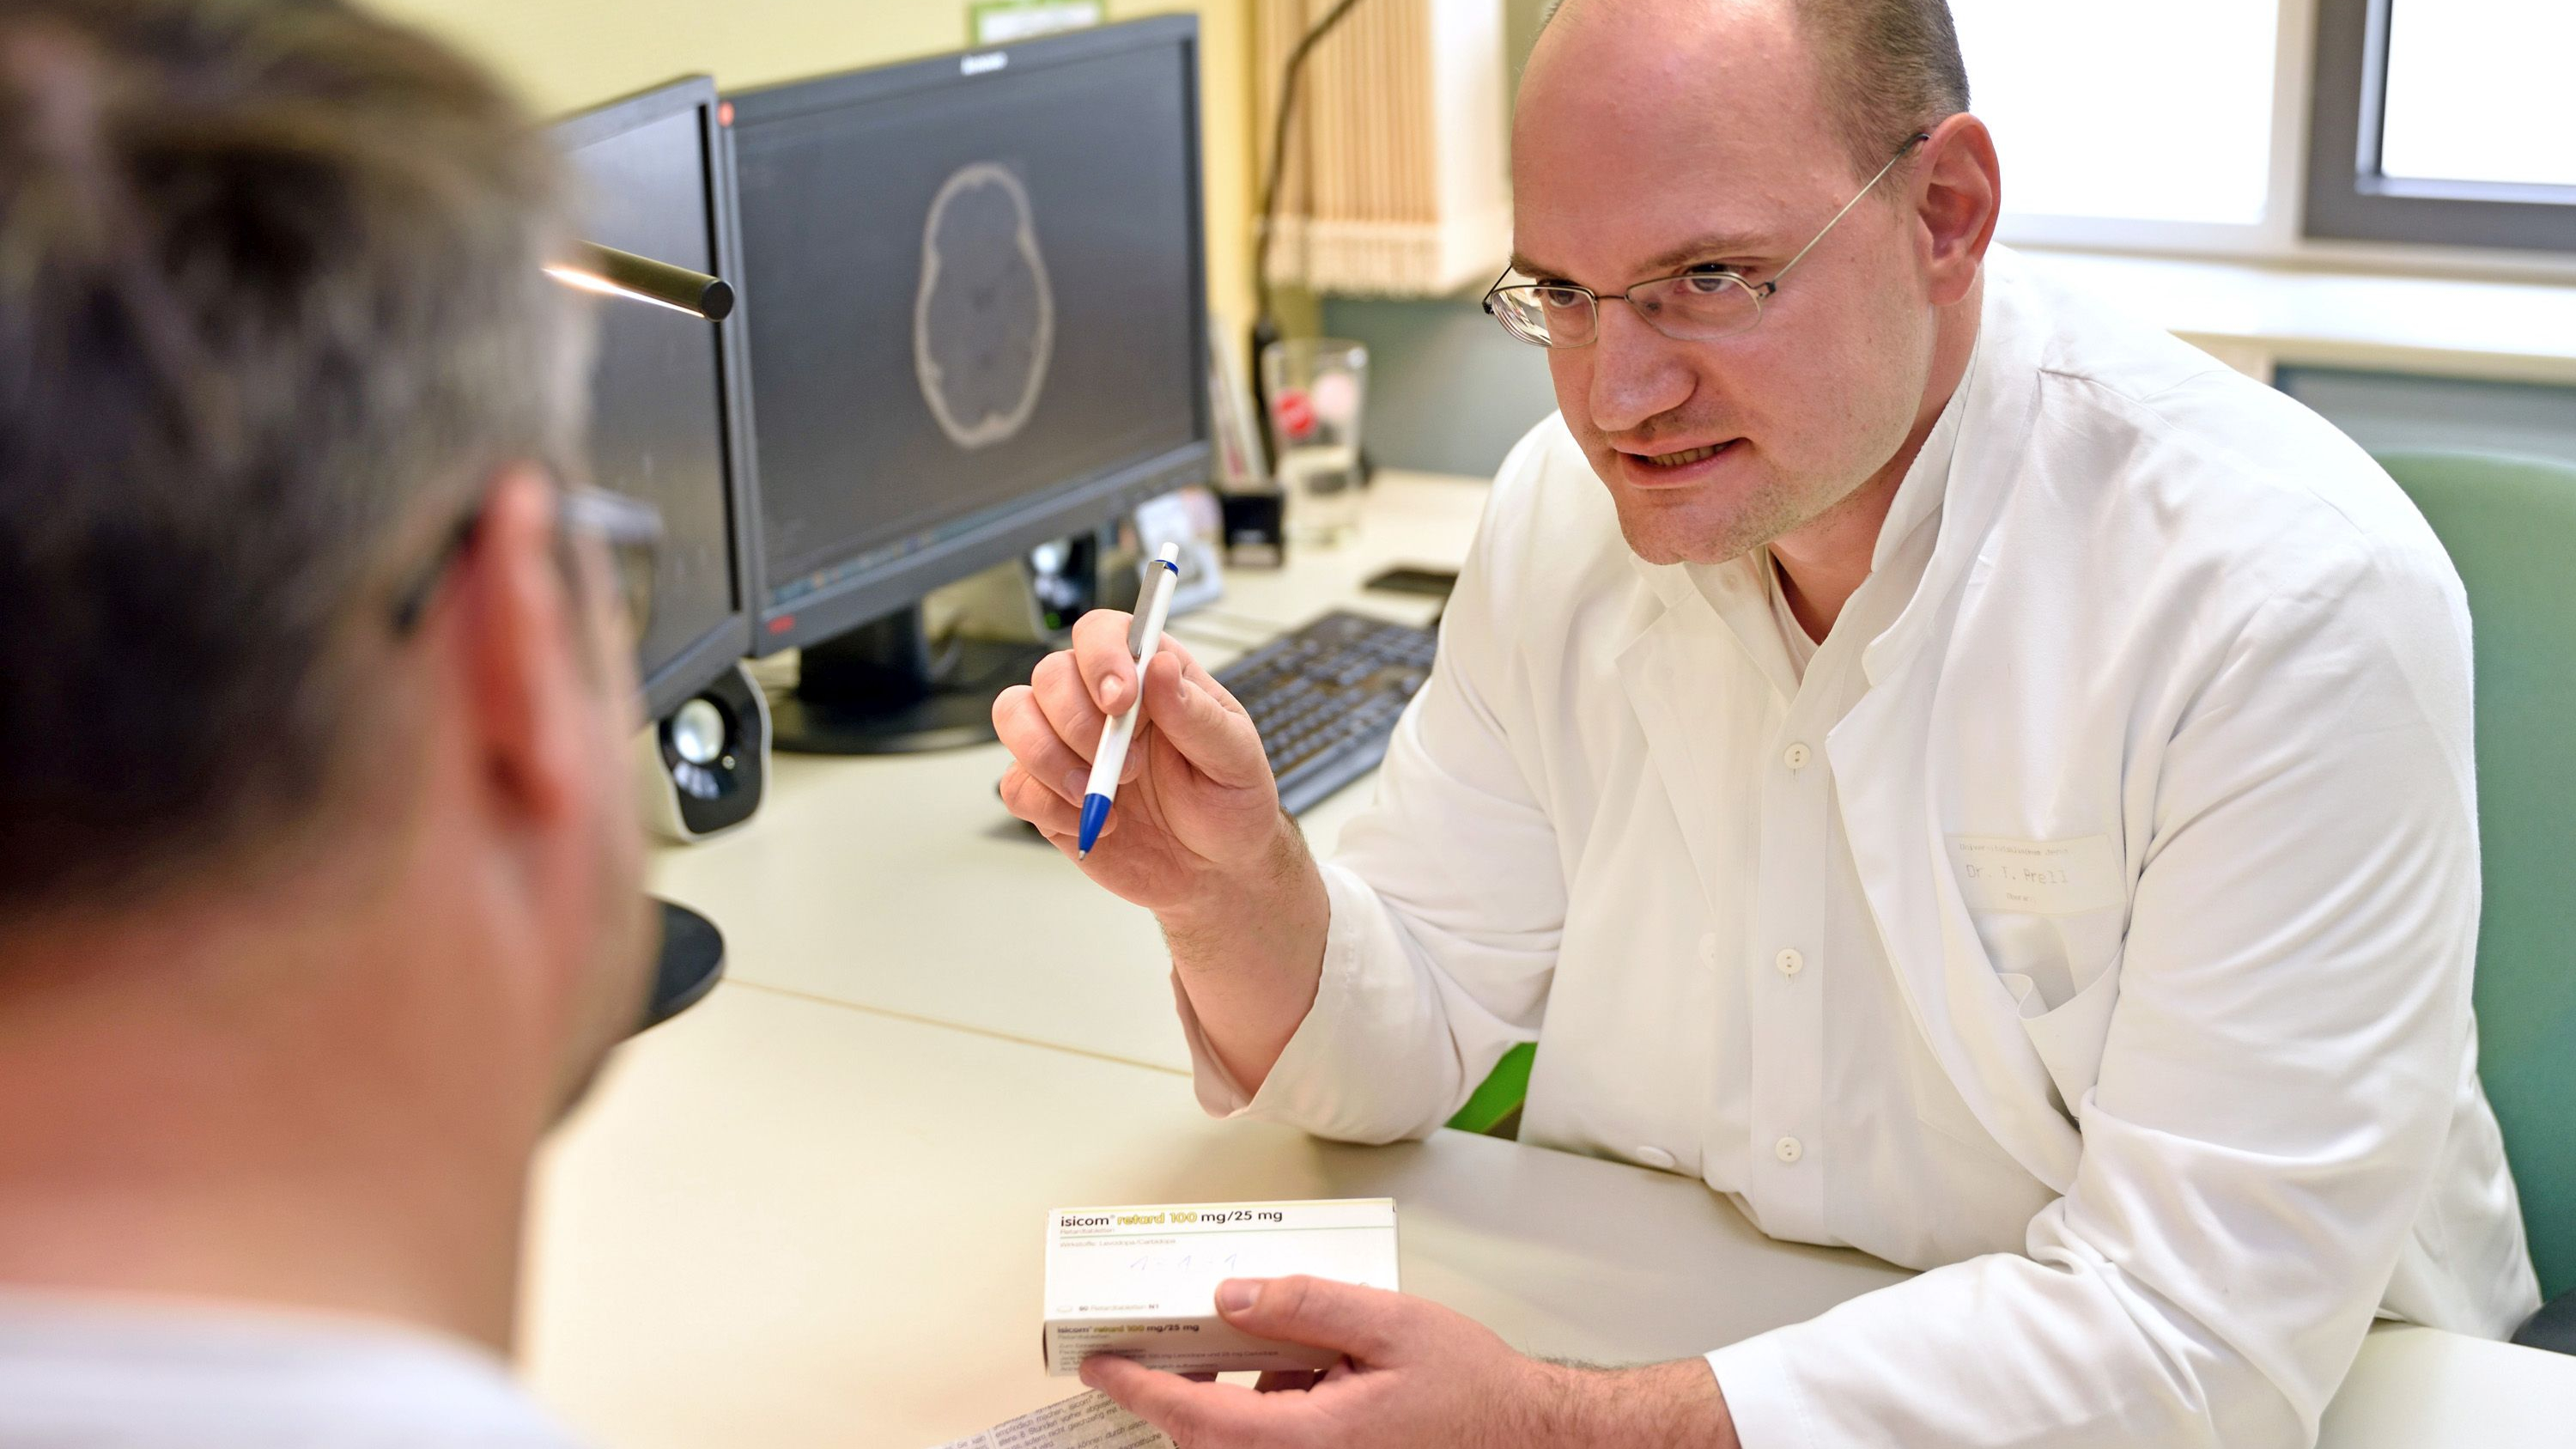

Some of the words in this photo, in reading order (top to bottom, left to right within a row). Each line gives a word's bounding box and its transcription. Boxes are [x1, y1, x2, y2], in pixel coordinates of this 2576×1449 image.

[2023, 868, 2069, 885] Prell
[1117, 1213, 1164, 1226] retard
[1170, 1211, 1198, 1225] 100
[1201, 1210, 1252, 1224] mg/25
[1258, 1211, 1283, 1222] mg
[1183, 1324, 1200, 1333] mg
[1105, 1426, 1127, 1440] durch
